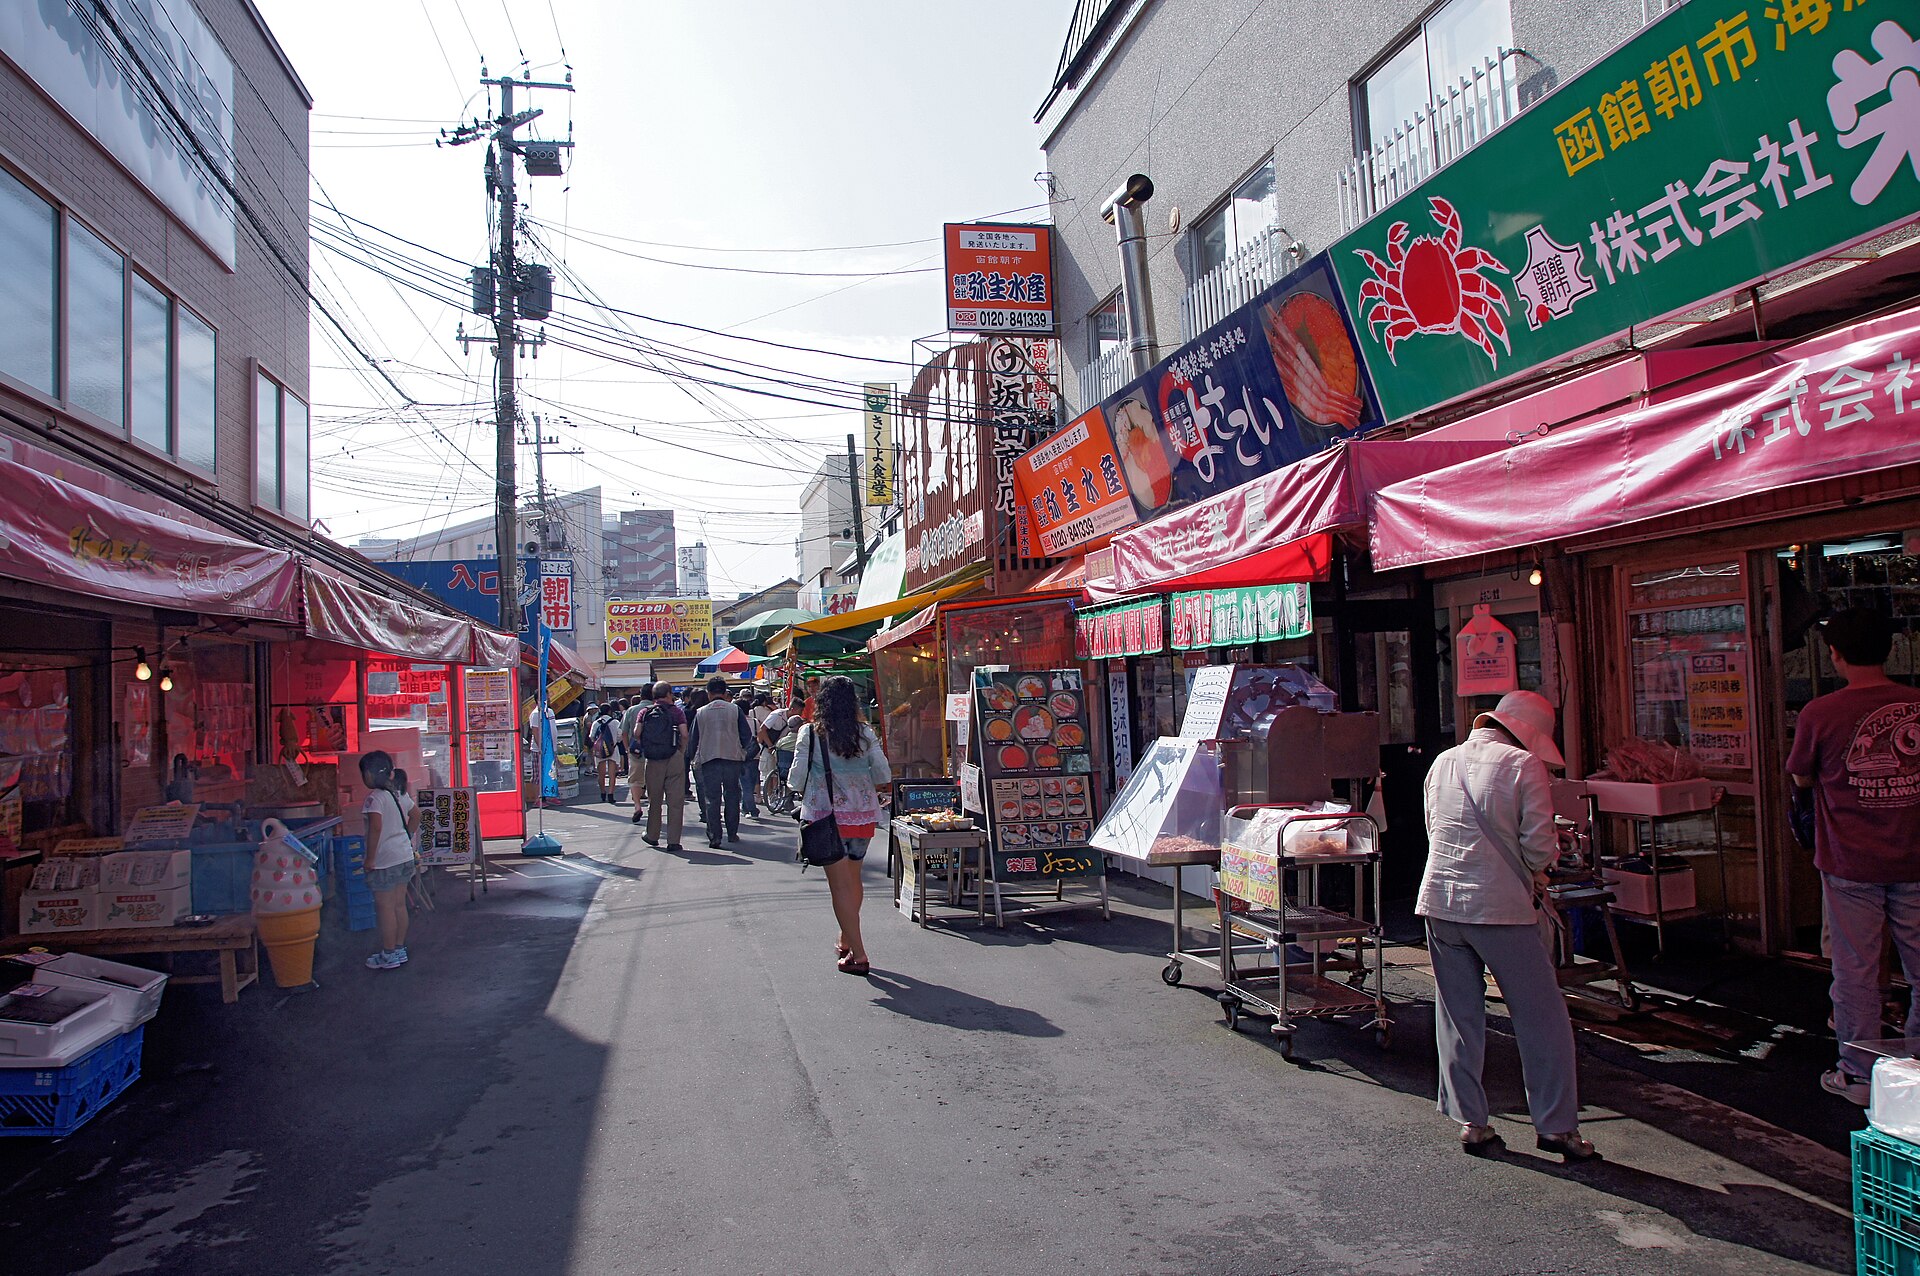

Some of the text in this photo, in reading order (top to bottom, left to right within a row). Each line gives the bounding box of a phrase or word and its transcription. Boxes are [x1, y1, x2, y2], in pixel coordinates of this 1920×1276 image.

[1552, 10, 1758, 177] 函館朝市
[1589, 118, 1834, 285] 株式会社
[976, 255, 1022, 264] 函館朝市
[1532, 254, 1564, 284] 函館
[968, 270, 1047, 304] 弥生水産
[1538, 276, 1571, 306] 朝市
[1032, 343, 1050, 411] 函館朝市
[1169, 415, 1201, 454] 栄屋
[1187, 375, 1283, 483] よさこい
[872, 414, 887, 497] きくよ食堂
[1043, 453, 1123, 522] 弥生水産
[1018, 515, 1031, 556] 弥生水産
[1149, 485, 1268, 565] 株式会社 栄屋
[541, 562, 572, 574] はこだて
[542, 577, 570, 628] 朝市
[608, 617, 678, 633] ようこそ函館朝市へ
[630, 632, 711, 652] 仲通り・朝市ドーム
[1694, 656, 1724, 668] OTS
[1111, 677, 1121, 768] クラシック
[1118, 676, 1128, 749] サッポロ
[995, 781, 1019, 790] ミニ丼
[1848, 776, 1886, 788] HOME
[1859, 788, 1875, 798] IN
[436, 795, 451, 827] 釣って
[453, 790, 470, 853] いか釣り体験
[420, 809, 436, 851] 食べよう
[1006, 852, 1092, 874] 栄屋 よさこい
[1226, 877, 1244, 894] 1050
[1255, 887, 1275, 905] 1050
